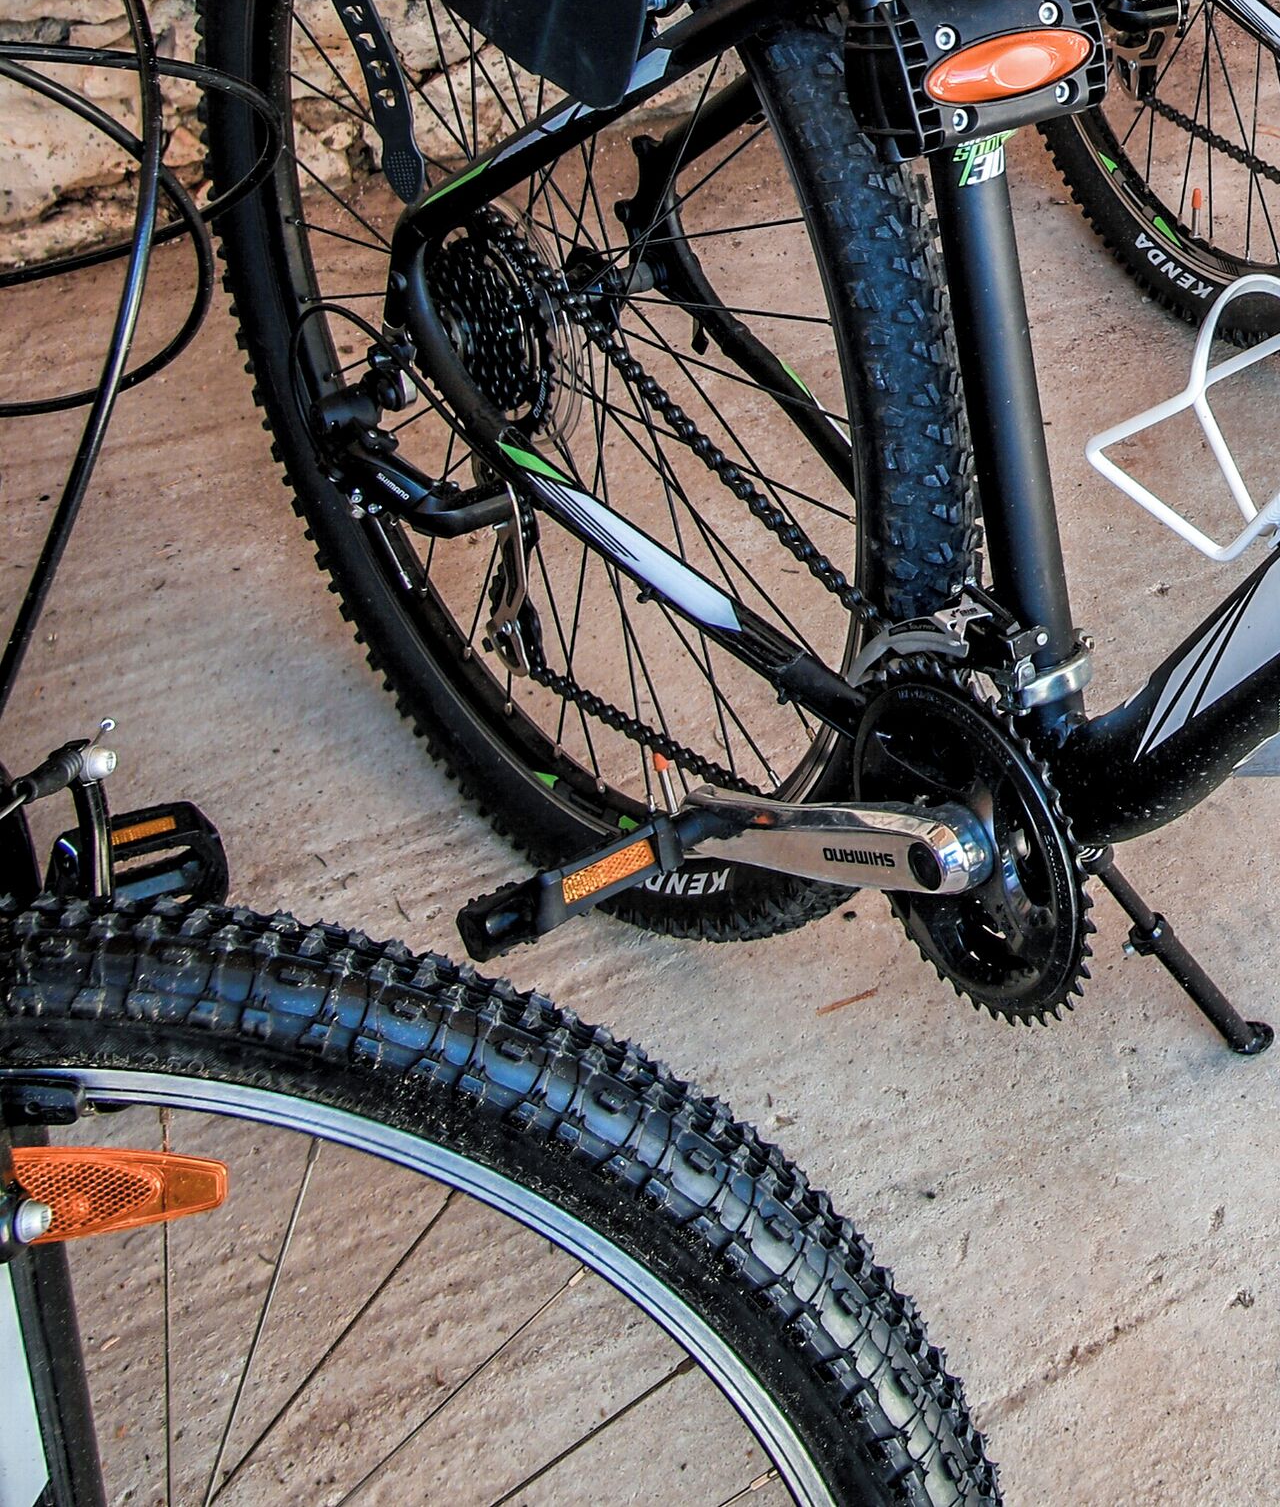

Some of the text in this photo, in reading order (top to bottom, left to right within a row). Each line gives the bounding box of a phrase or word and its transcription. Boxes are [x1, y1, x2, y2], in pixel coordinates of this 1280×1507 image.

[1134, 232, 1214, 299] KENDA
[375, 471, 411, 502] SHIMANO
[822, 847, 896, 868] SHIMANO
[643, 866, 731, 896] KEND
